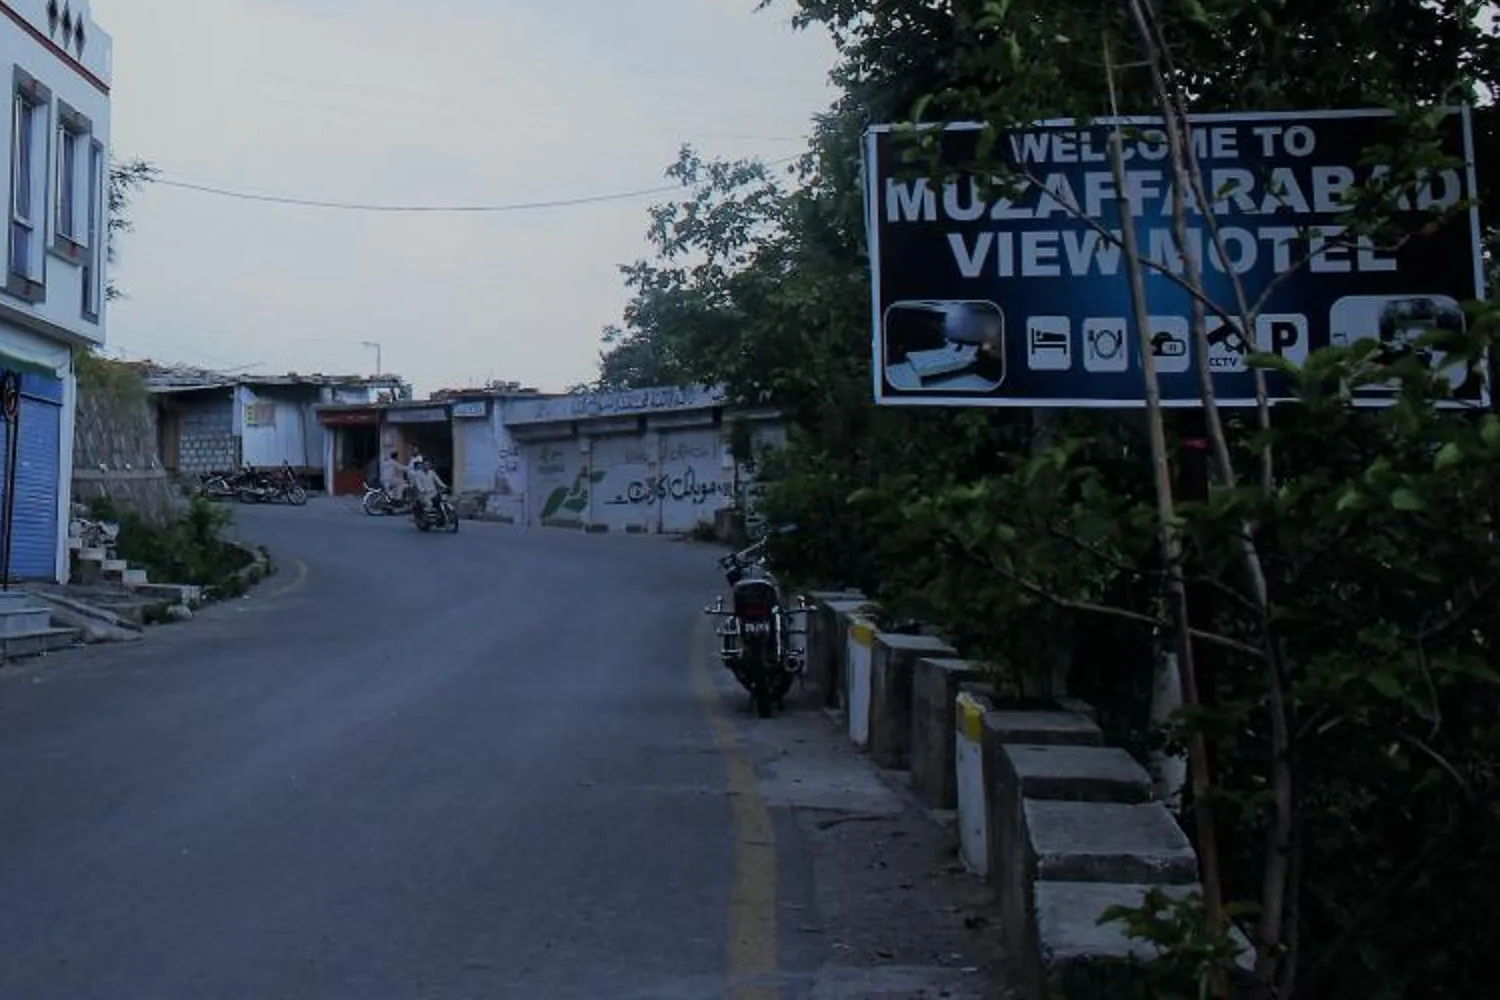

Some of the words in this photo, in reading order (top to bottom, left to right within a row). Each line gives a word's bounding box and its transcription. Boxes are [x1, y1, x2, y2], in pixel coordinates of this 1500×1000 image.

[1252, 124, 1317, 158] TO
[947, 229, 1125, 278] VIEW
[1149, 225, 1398, 275] MOTEL
[1271, 321, 1298, 355] P
